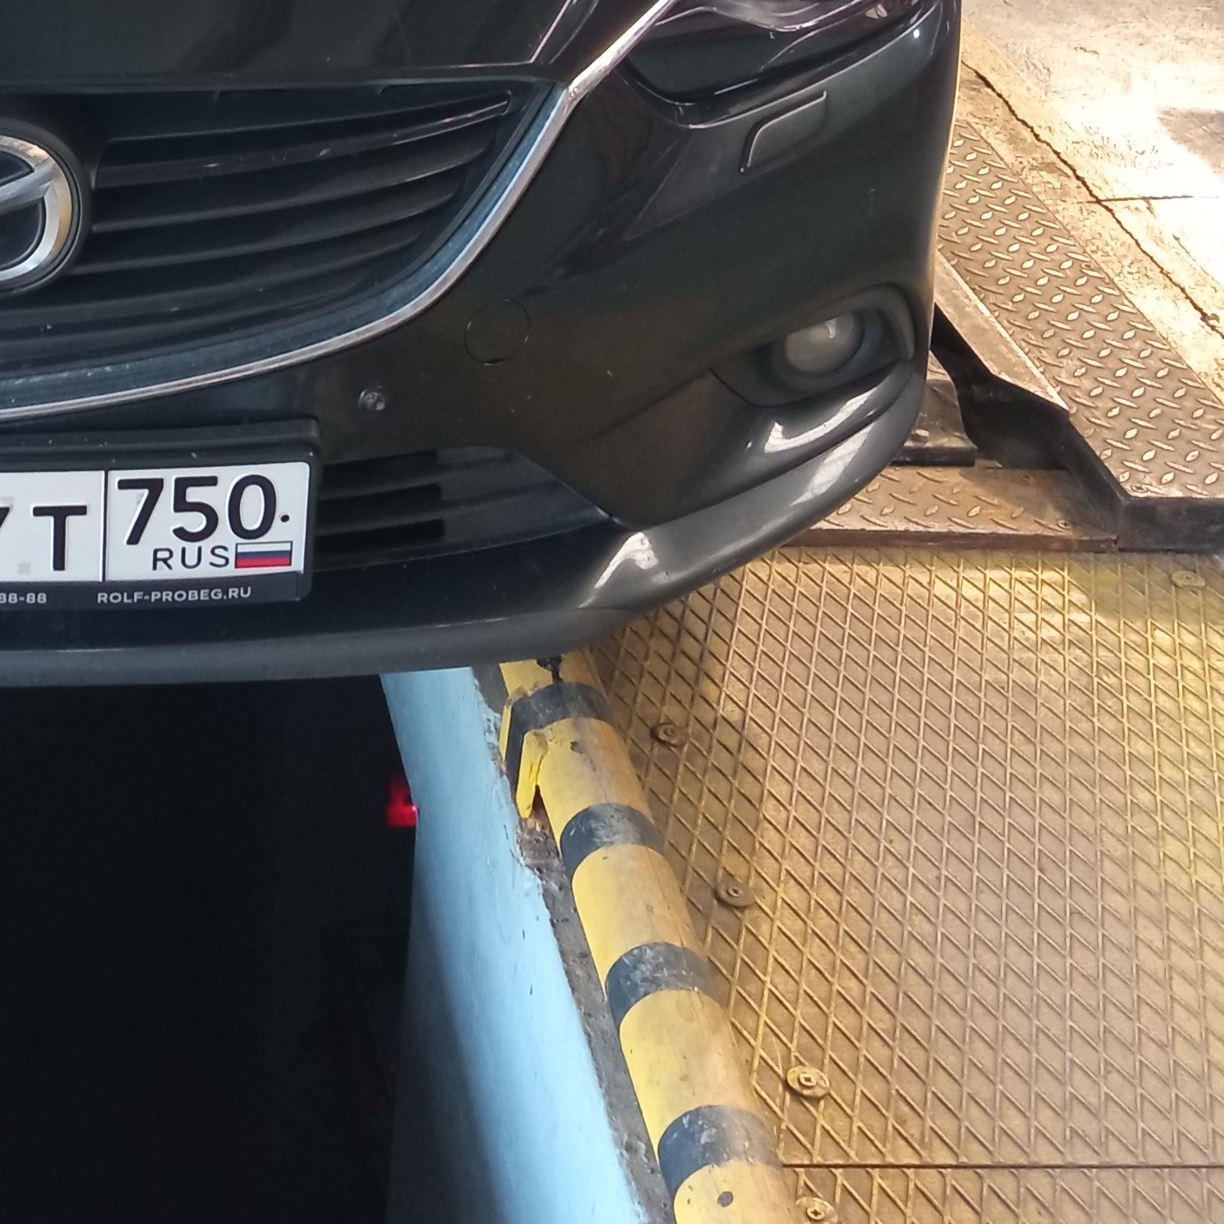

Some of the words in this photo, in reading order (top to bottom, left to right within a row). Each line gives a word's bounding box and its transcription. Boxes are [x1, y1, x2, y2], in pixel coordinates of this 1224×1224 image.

[117, 474, 277, 546] 750
[152, 545, 230, 571] RUS
[97, 586, 252, 605] ROLF-PROBEG.RU
